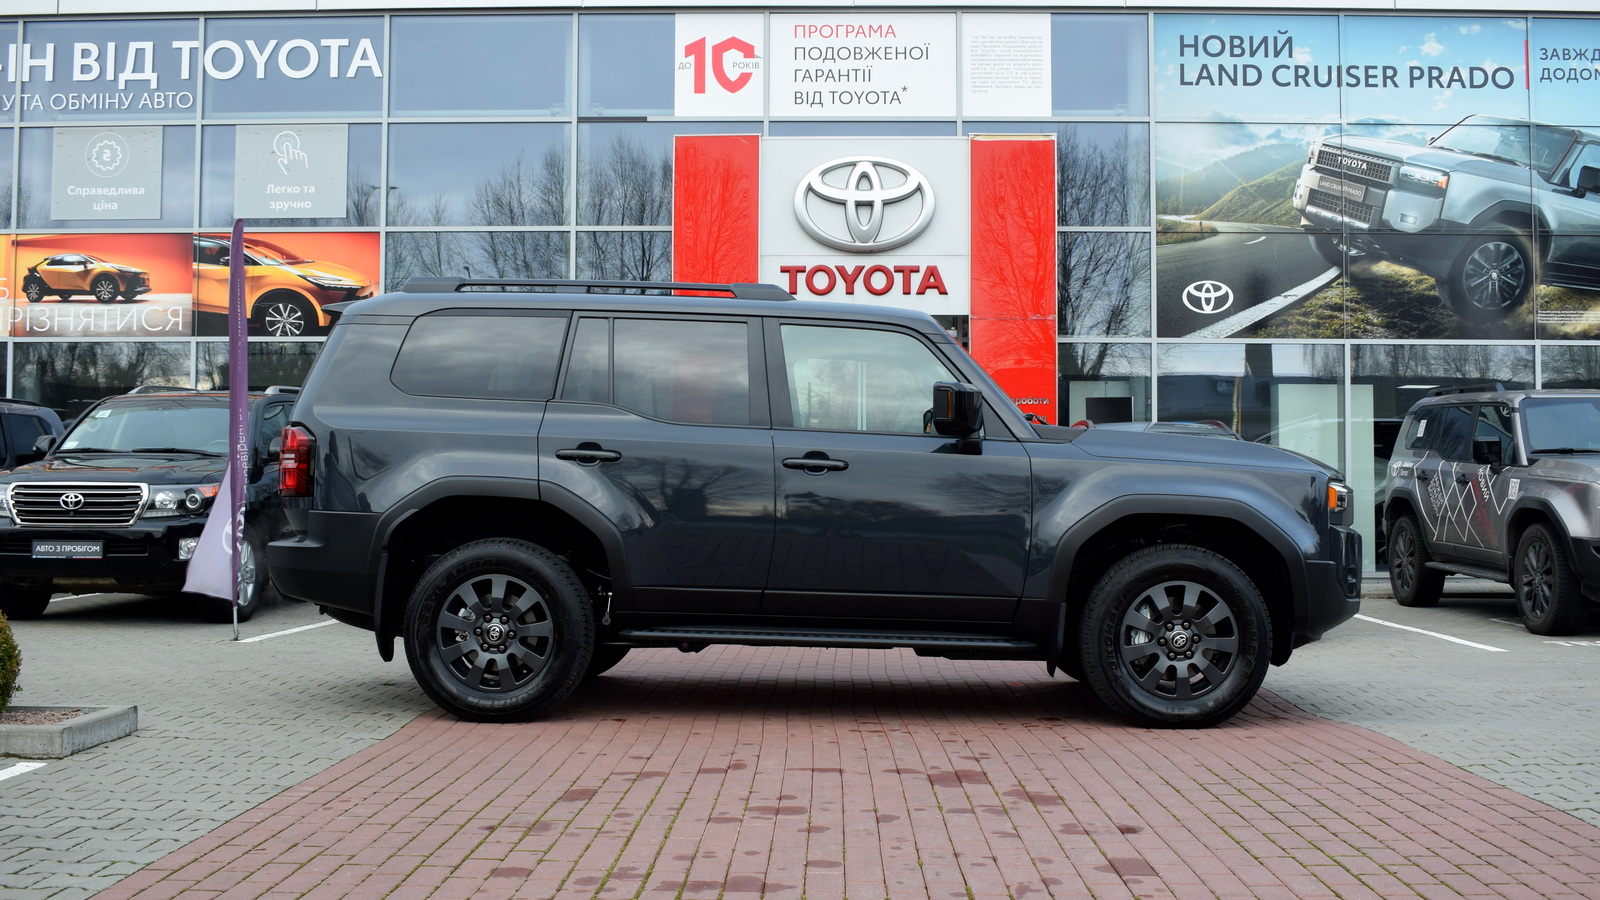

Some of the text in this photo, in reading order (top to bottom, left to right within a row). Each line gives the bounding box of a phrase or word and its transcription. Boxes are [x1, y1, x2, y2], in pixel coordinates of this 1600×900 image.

[793, 24, 896, 39] ПРОГРАМА
[793, 43, 930, 63] ПОДОВЖЕНОЇ
[1178, 30, 1294, 59] НОВИЙ
[0, 38, 383, 90] ІН ВІД TOYOTA
[678, 62, 692, 70] ДО
[793, 65, 872, 83] ГАРАНТІЇ
[1179, 63, 1515, 90] LAND CRUISER PRADO
[21, 93, 44, 111] ТА
[50, 92, 135, 111] ОБМІНУ
[138, 91, 194, 110] АВТО
[793, 90, 824, 108] ВІД
[1337, 156, 1367, 170] TOYOTA
[67, 185, 145, 197] Справедлива
[266, 184, 316, 196] Легко та
[93, 199, 118, 212] ціна
[269, 200, 312, 211] зручно
[780, 265, 948, 295] TOYOTA
[0, 306, 183, 332] РІЗНЯТИСЯ
[1014, 396, 1050, 406] роботи
